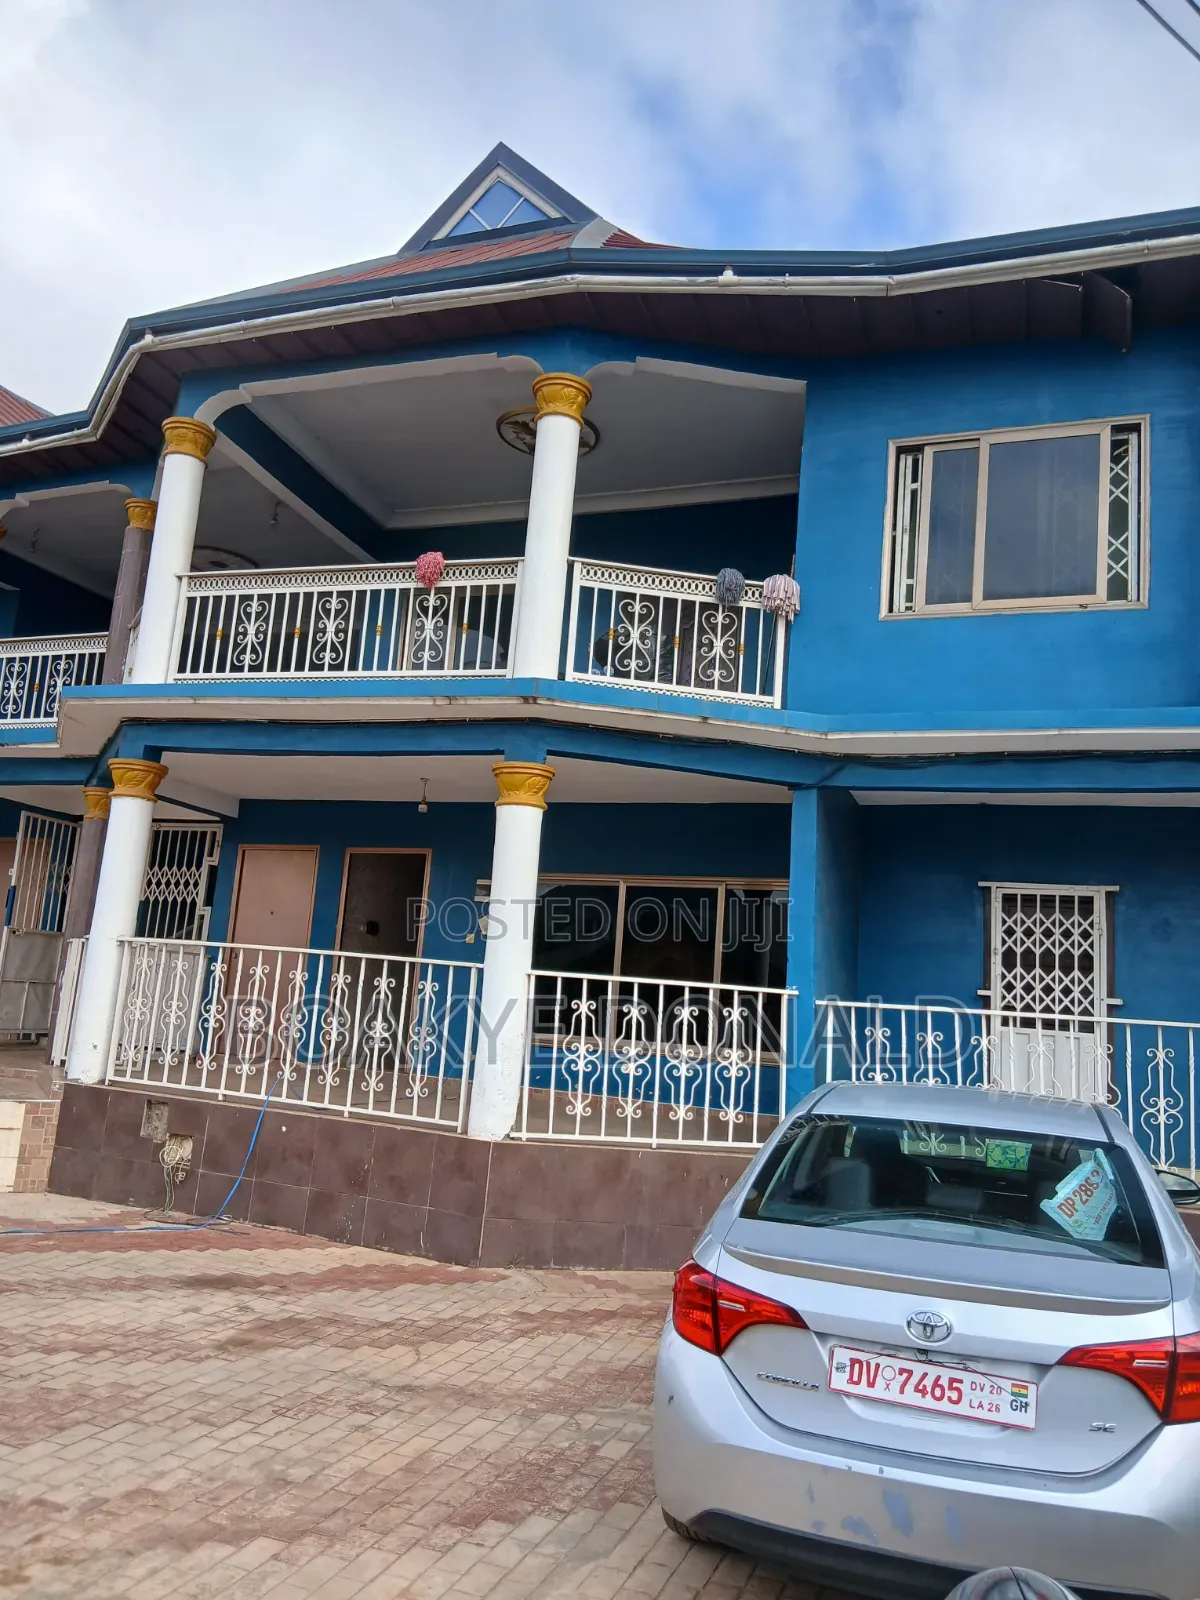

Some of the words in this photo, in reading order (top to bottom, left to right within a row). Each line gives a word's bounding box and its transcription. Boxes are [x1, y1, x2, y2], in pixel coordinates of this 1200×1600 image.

[1056, 1196, 1079, 1219] DP
[847, 1357, 881, 1388] DV
[897, 1367, 964, 1405] 7465
[883, 1381, 892, 1393] X
[970, 1381, 986, 1393] DV
[989, 1385, 1002, 1396] 20
[969, 1398, 985, 1411] LA
[987, 1401, 1001, 1413] 26
[1010, 1398, 1029, 1414] GH
